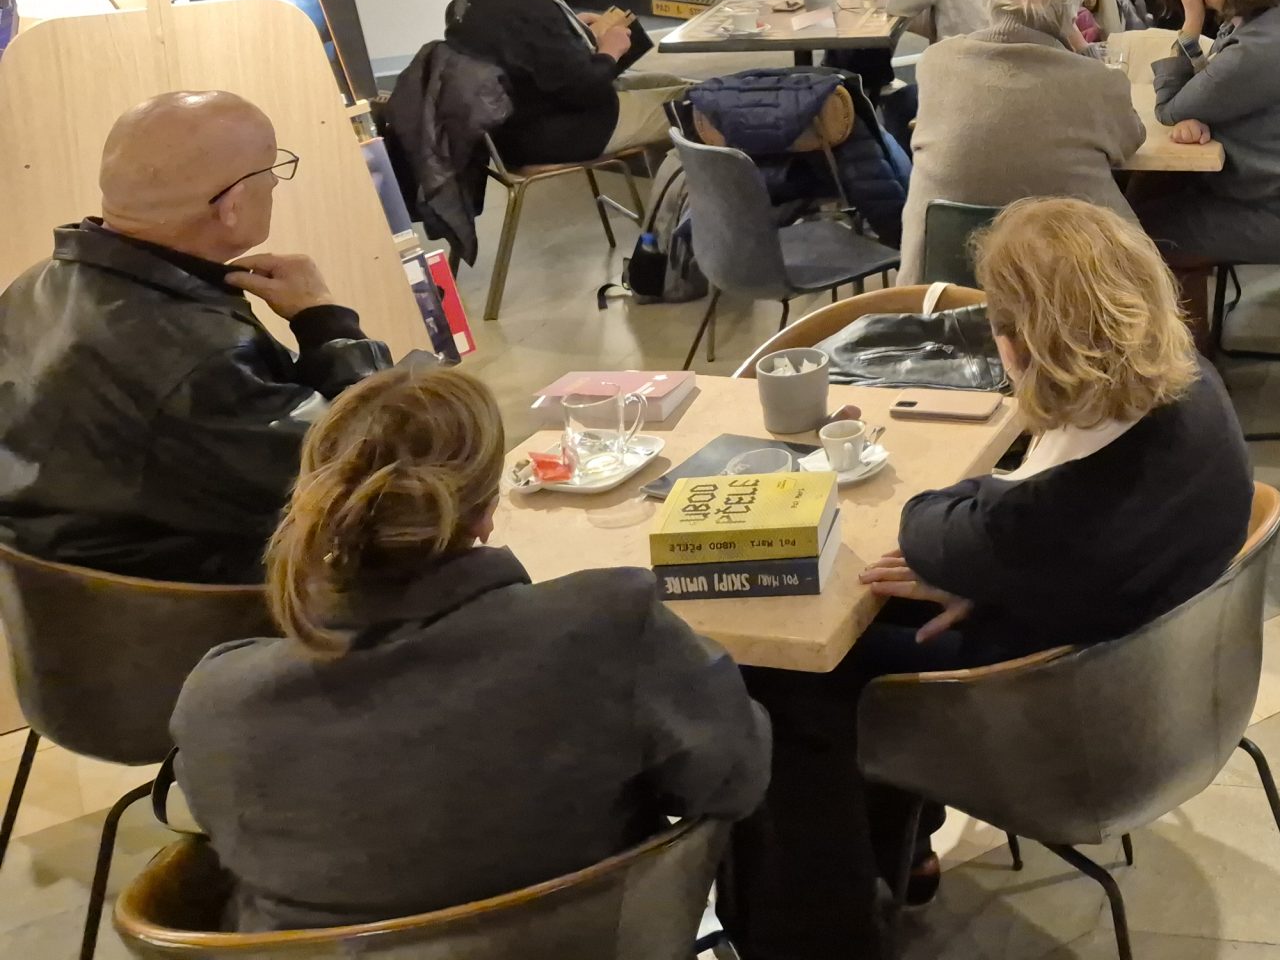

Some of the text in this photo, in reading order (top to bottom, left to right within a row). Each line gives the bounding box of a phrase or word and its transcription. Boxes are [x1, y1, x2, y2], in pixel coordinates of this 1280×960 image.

[679, 483, 719, 522] UBOD
[714, 478, 760, 524] PČELE
[779, 538, 796, 547] Pol
[664, 575, 709, 594] UMIRE
[714, 571, 751, 592] SKIPI
